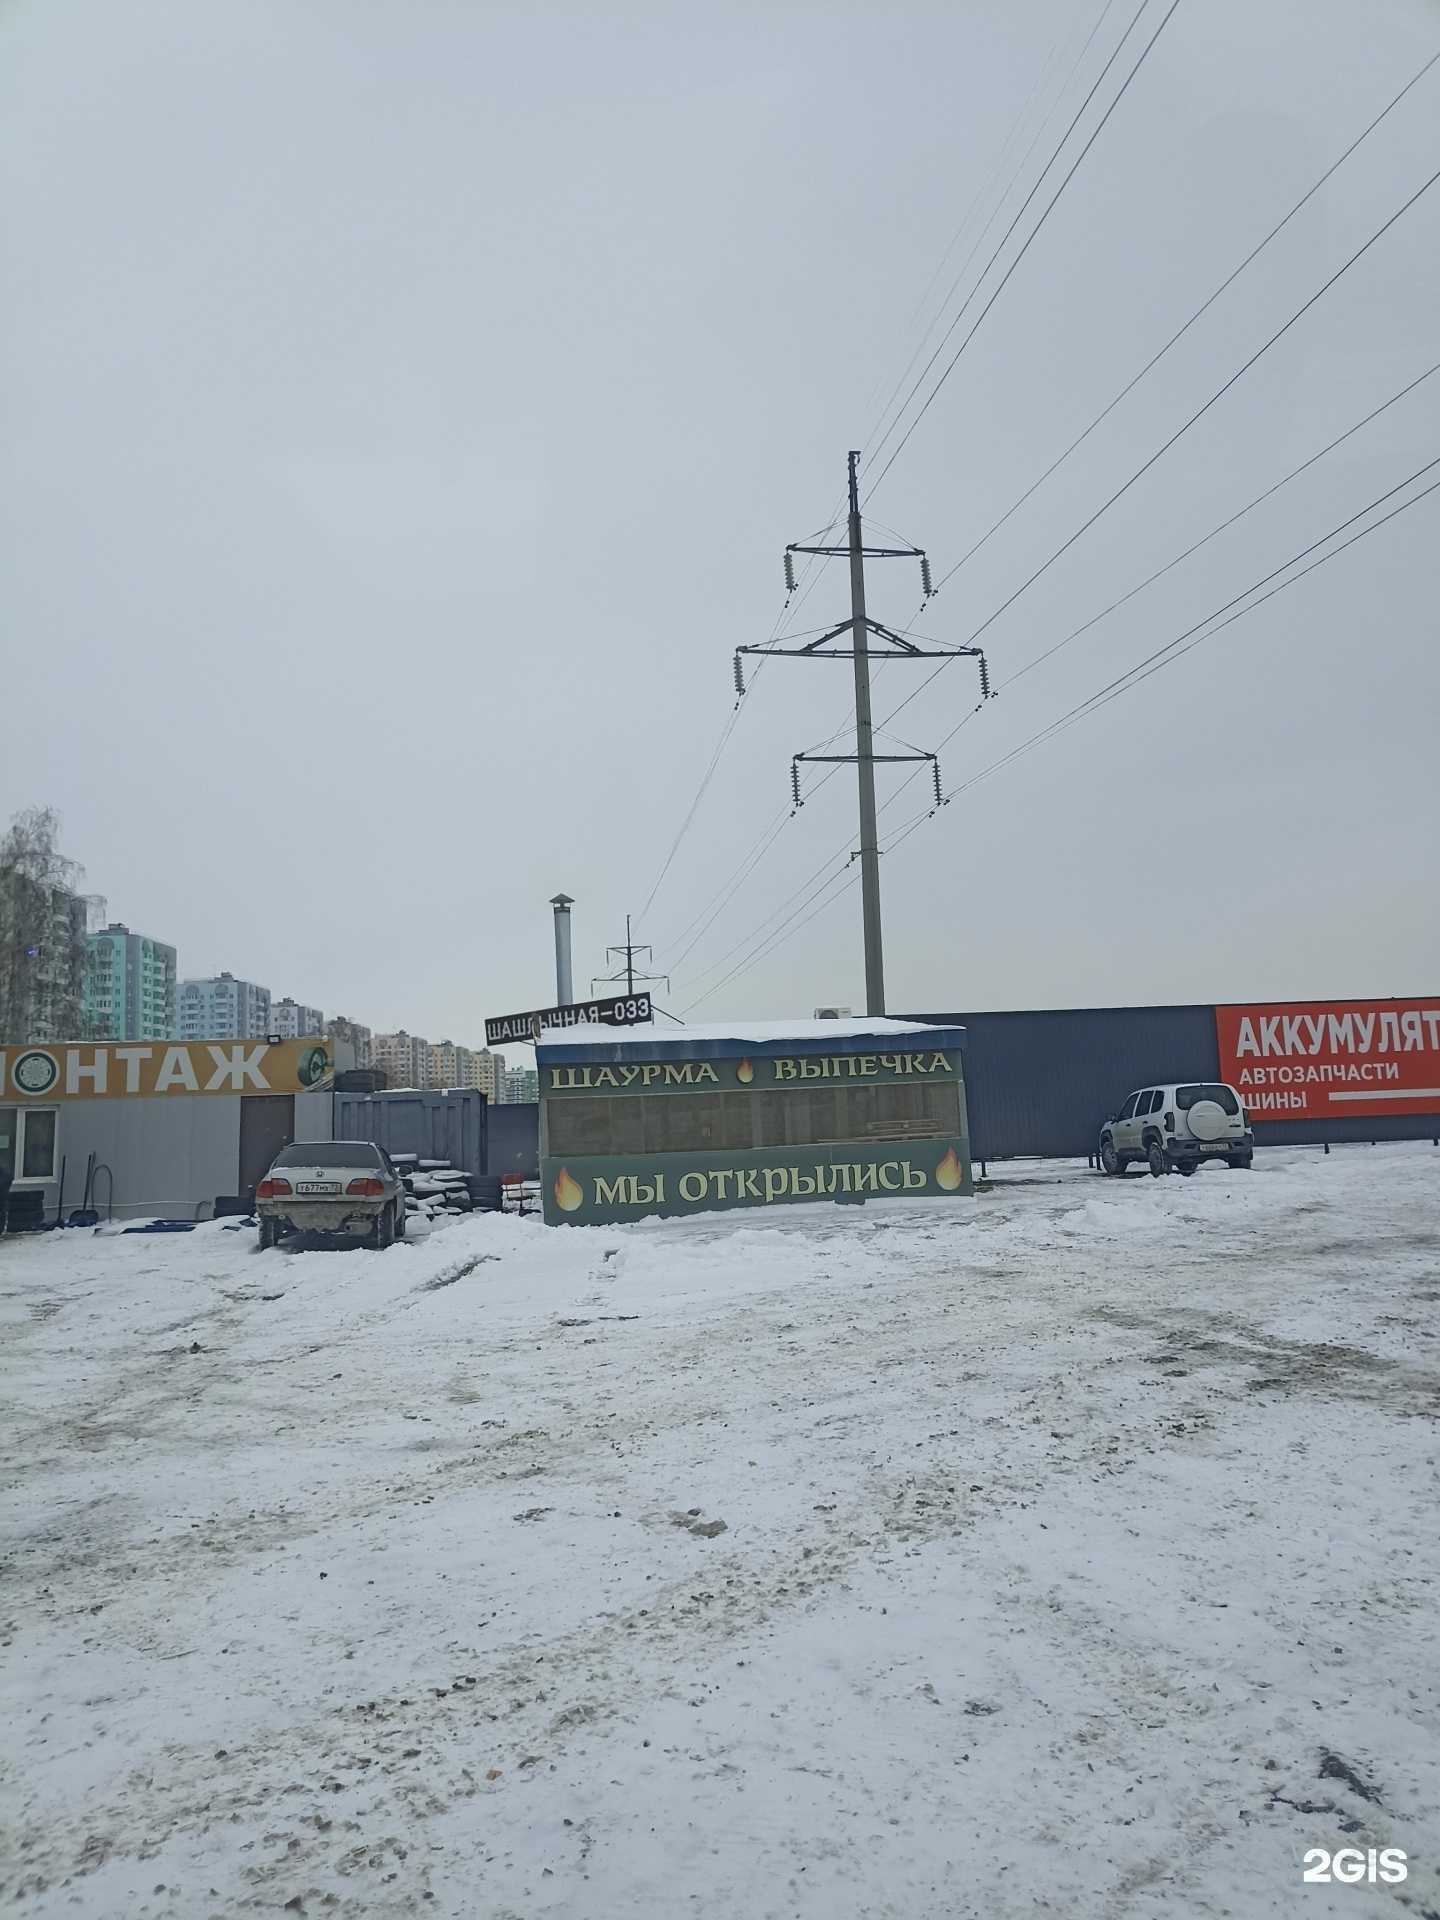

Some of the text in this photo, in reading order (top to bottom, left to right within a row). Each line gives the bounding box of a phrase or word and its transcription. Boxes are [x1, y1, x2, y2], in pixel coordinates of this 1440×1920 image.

[1236, 1010, 1440, 1058] АККУМУЛЯТ
[551, 1052, 953, 1089] ШАУРМА ВЫПЕЧКА
[1239, 1063, 1400, 1085] АВТОЗАПЧАСТИ
[1241, 1091, 1307, 1110] ШИНЫ
[592, 1174, 666, 1205] МЫ
